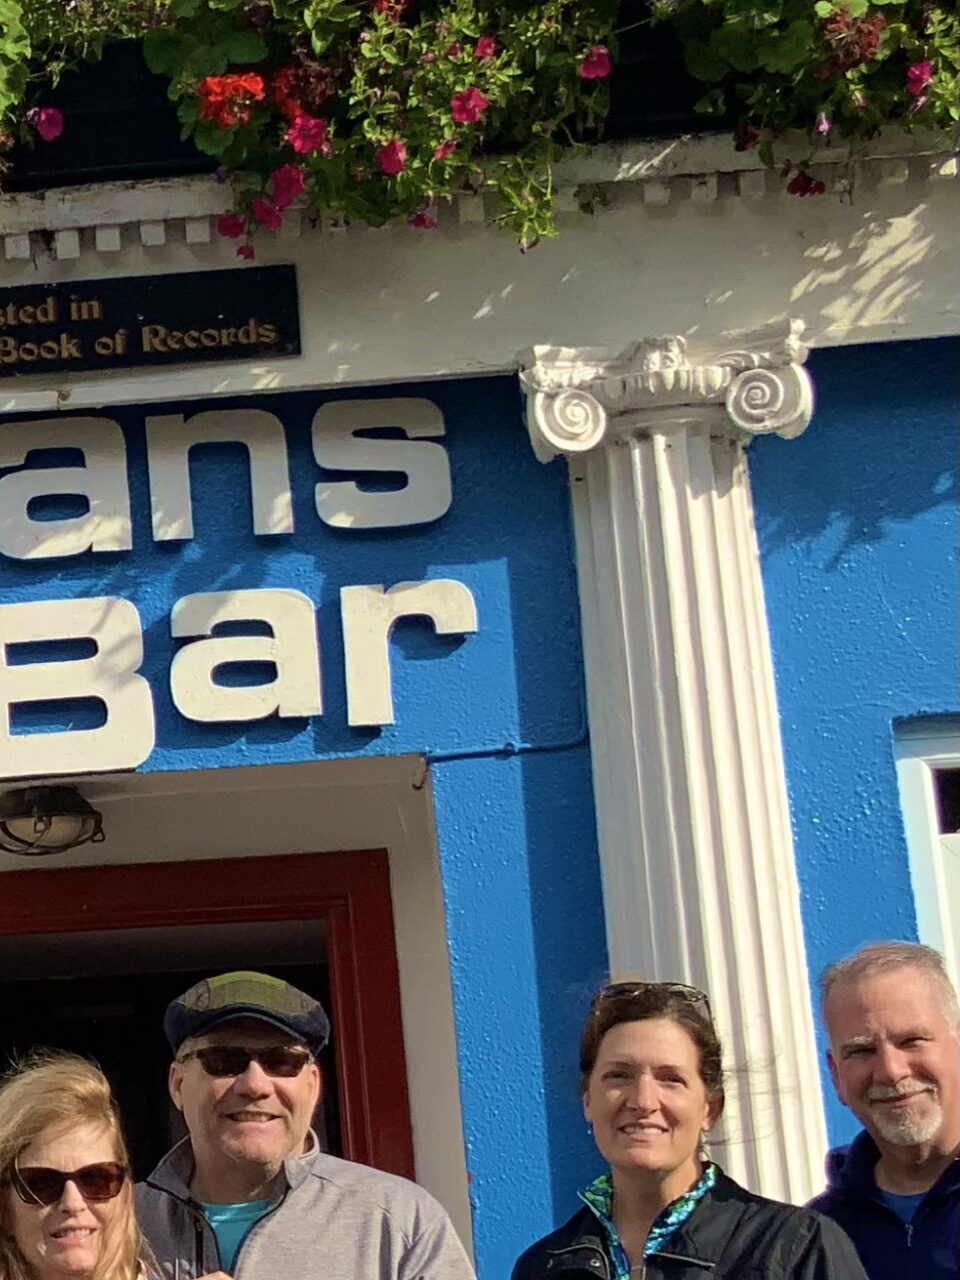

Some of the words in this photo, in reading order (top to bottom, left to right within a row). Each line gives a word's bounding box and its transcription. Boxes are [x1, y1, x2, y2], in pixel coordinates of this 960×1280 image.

[71, 294, 103, 321] in
[94, 328, 130, 356] of
[141, 317, 278, 353] Records
